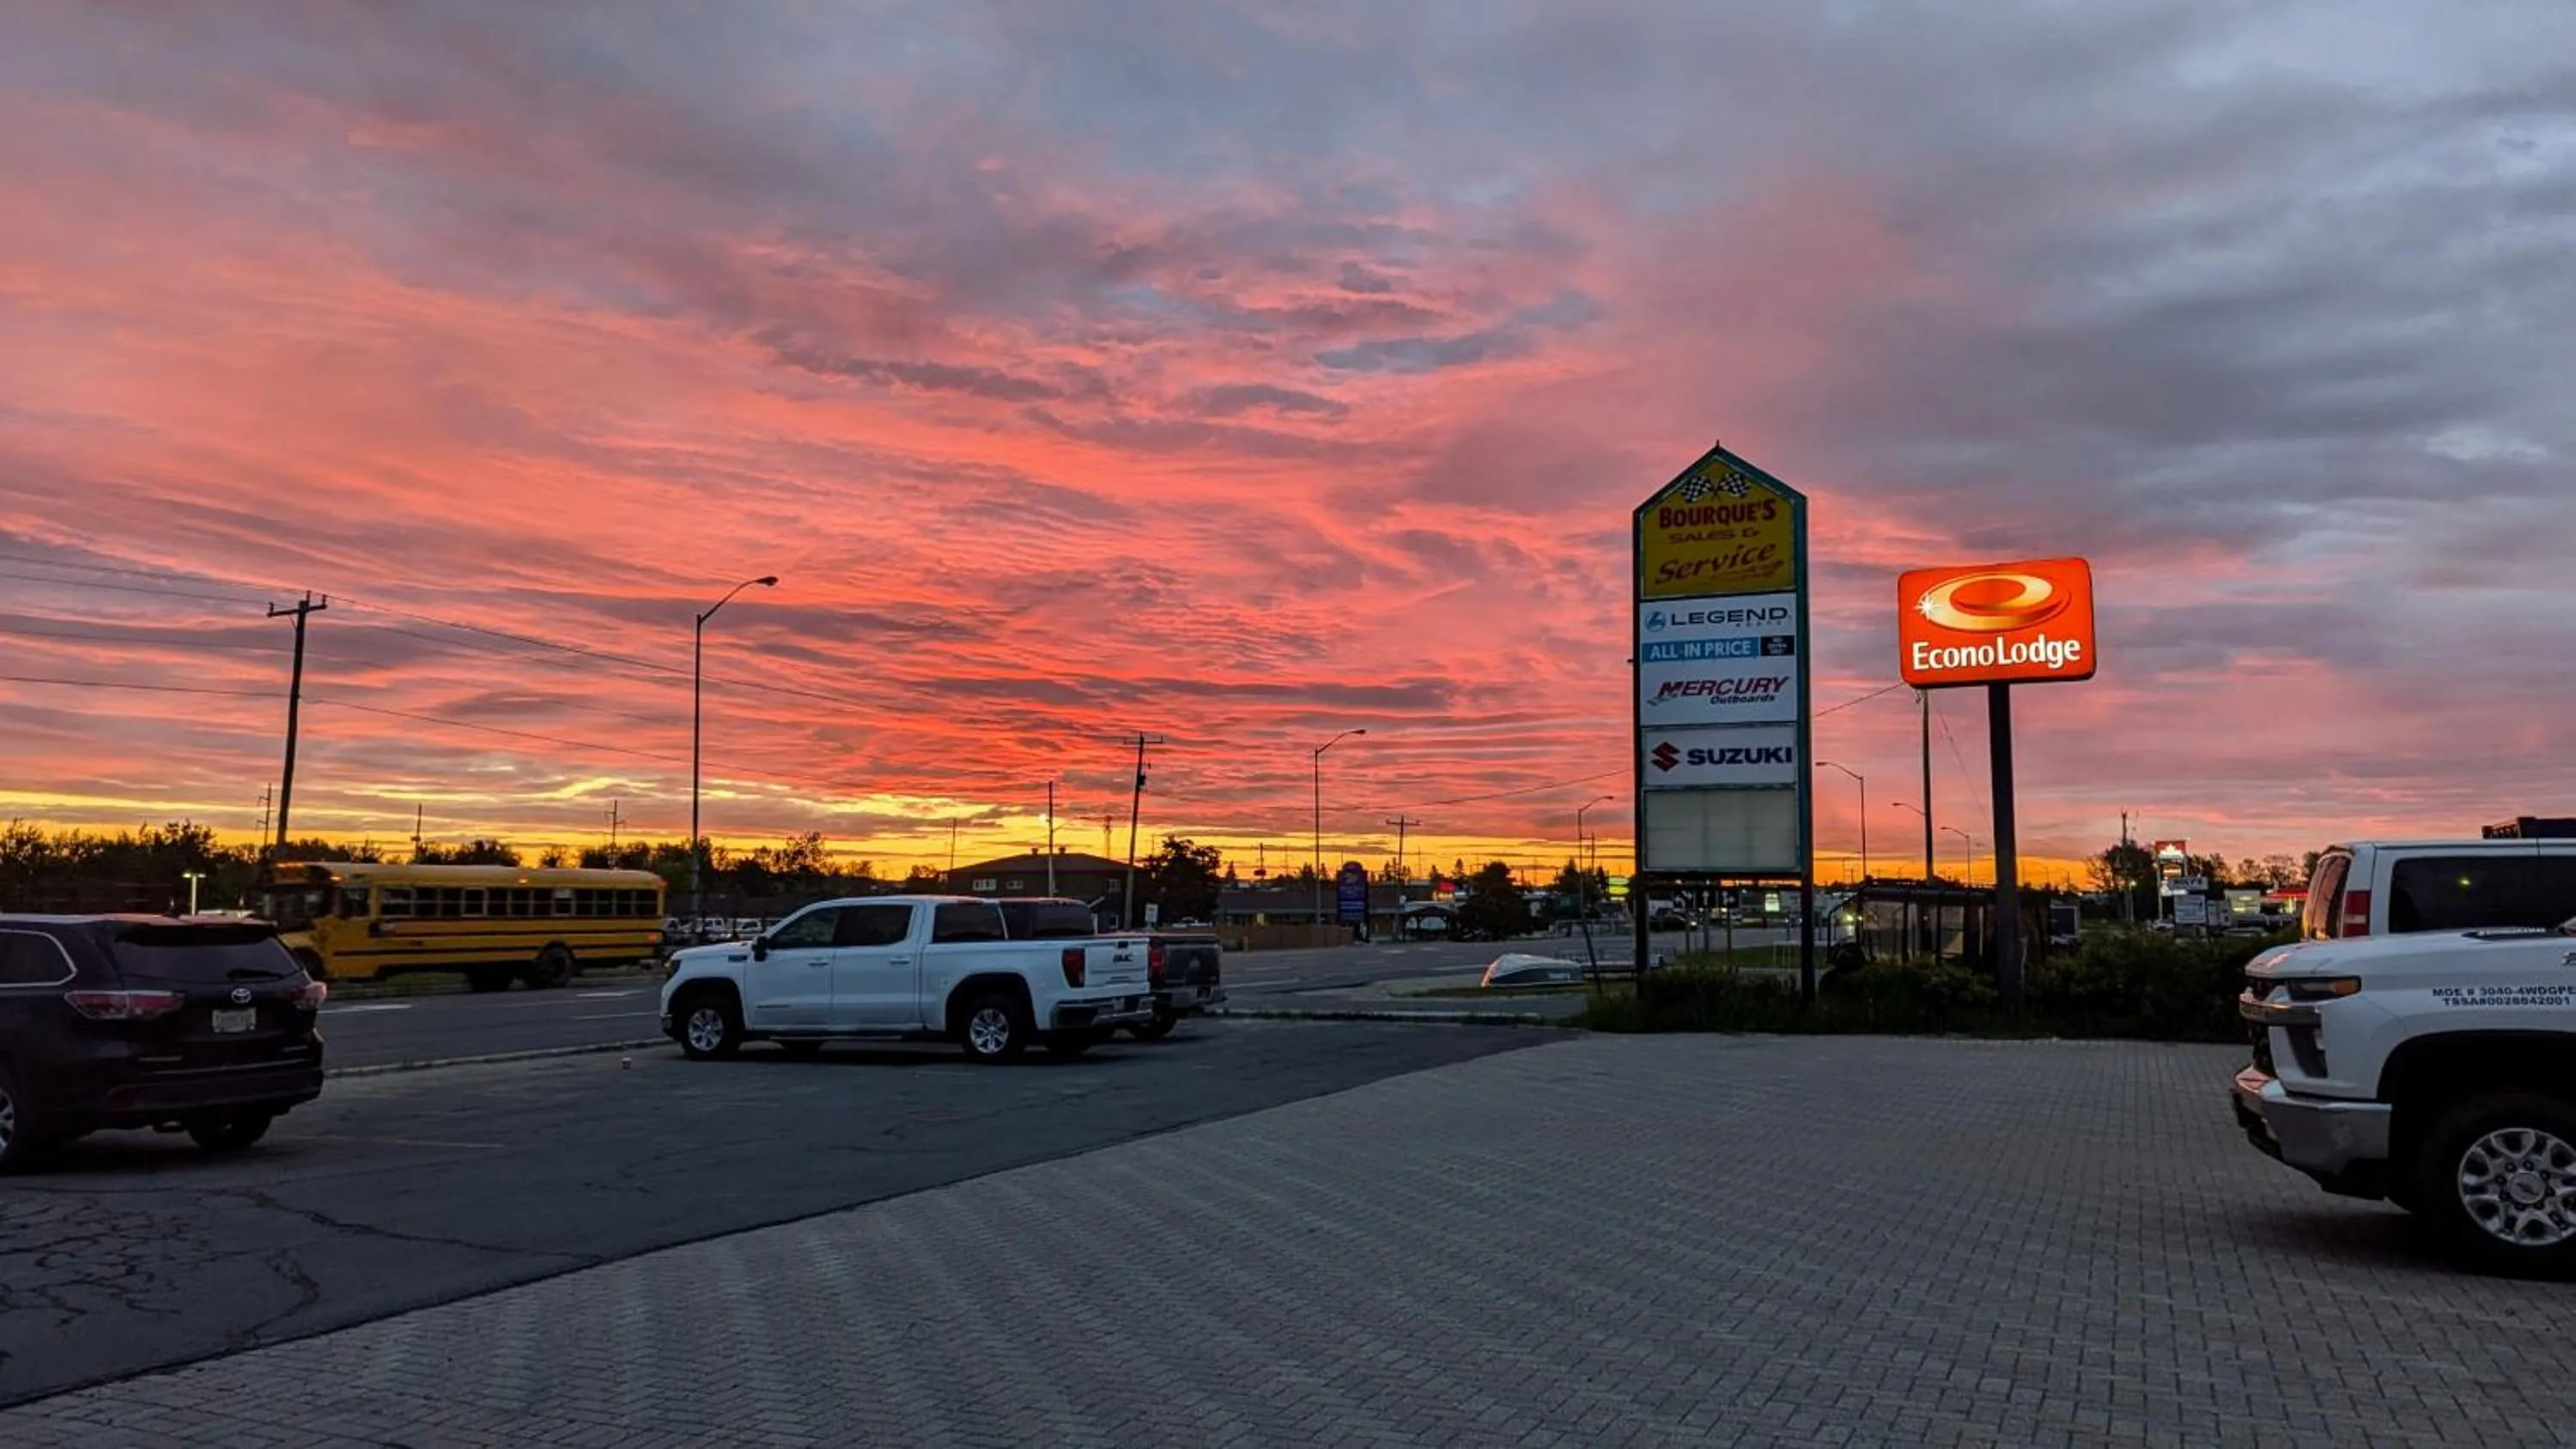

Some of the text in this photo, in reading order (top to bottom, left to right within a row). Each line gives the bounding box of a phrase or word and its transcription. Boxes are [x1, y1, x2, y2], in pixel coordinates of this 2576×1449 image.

[1659, 498, 1777, 530] BOURQUE'S
[1668, 529, 1735, 544] SALES
[1655, 543, 1777, 585] Service
[1671, 607, 1789, 626] LEGEND
[1704, 640, 1752, 657] PRICE
[1656, 676, 1791, 699] MERCURY
[1710, 694, 1777, 706] Outboards
[1686, 747, 1793, 766] SUZUKI
